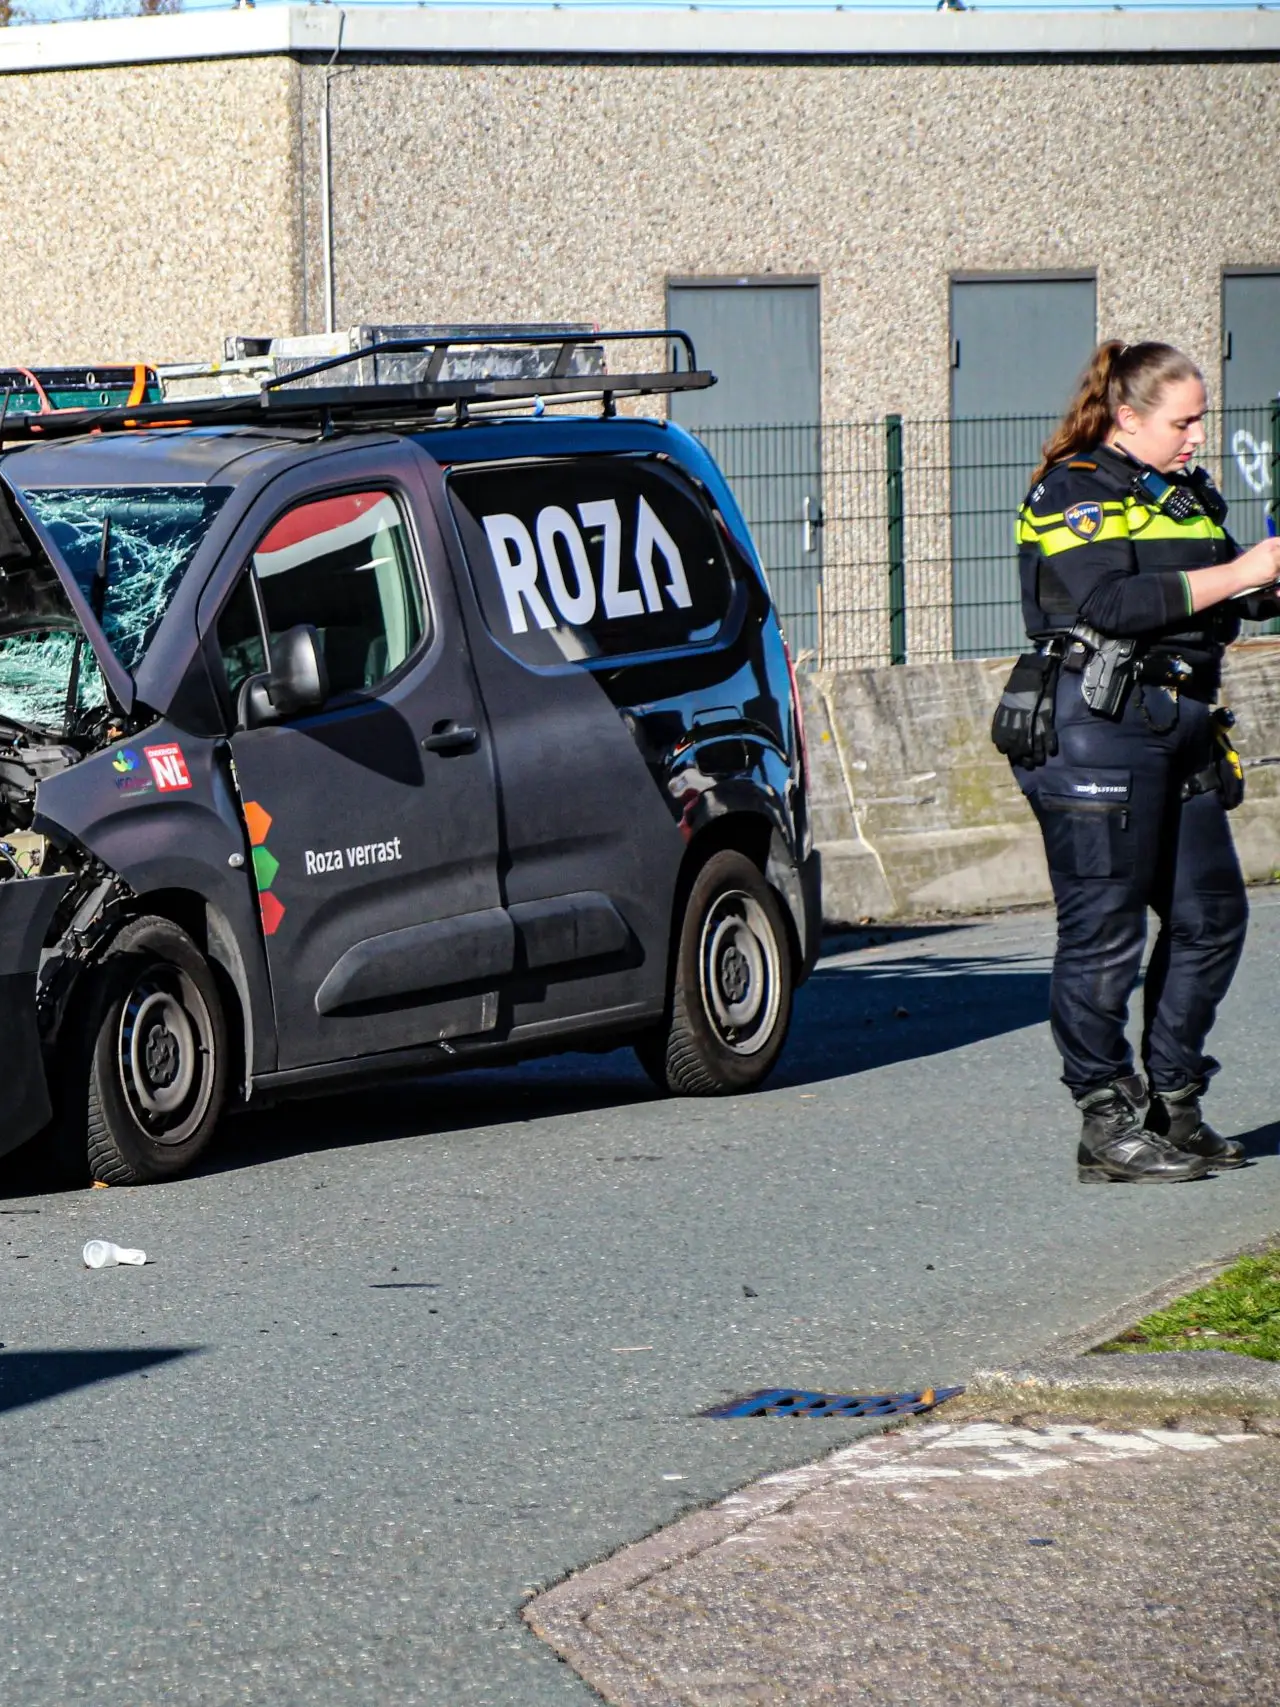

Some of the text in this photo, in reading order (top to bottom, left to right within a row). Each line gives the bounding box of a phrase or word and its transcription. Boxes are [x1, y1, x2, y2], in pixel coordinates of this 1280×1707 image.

[482, 494, 693, 634] ROZA
[151, 754, 189, 788] NL
[304, 836, 402, 875] Roza verrast
